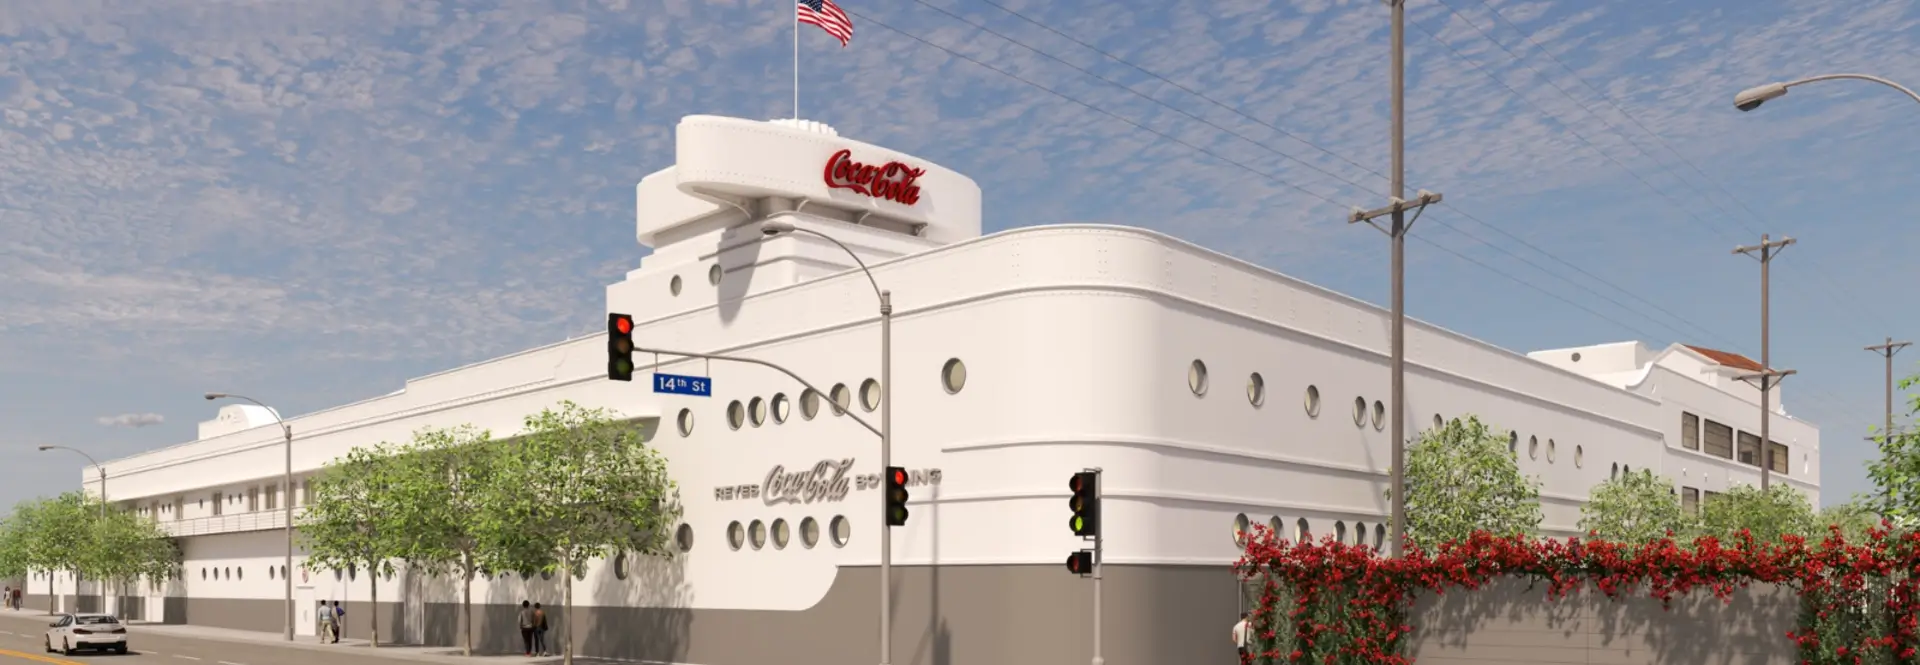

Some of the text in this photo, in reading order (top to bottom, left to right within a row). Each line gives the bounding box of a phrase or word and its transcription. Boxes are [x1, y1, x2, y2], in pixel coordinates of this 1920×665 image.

[824, 149, 926, 206] Coca-Cola
[659, 376, 706, 392] 14th St
[714, 457, 942, 507] REYES Coca-Cola BOING
